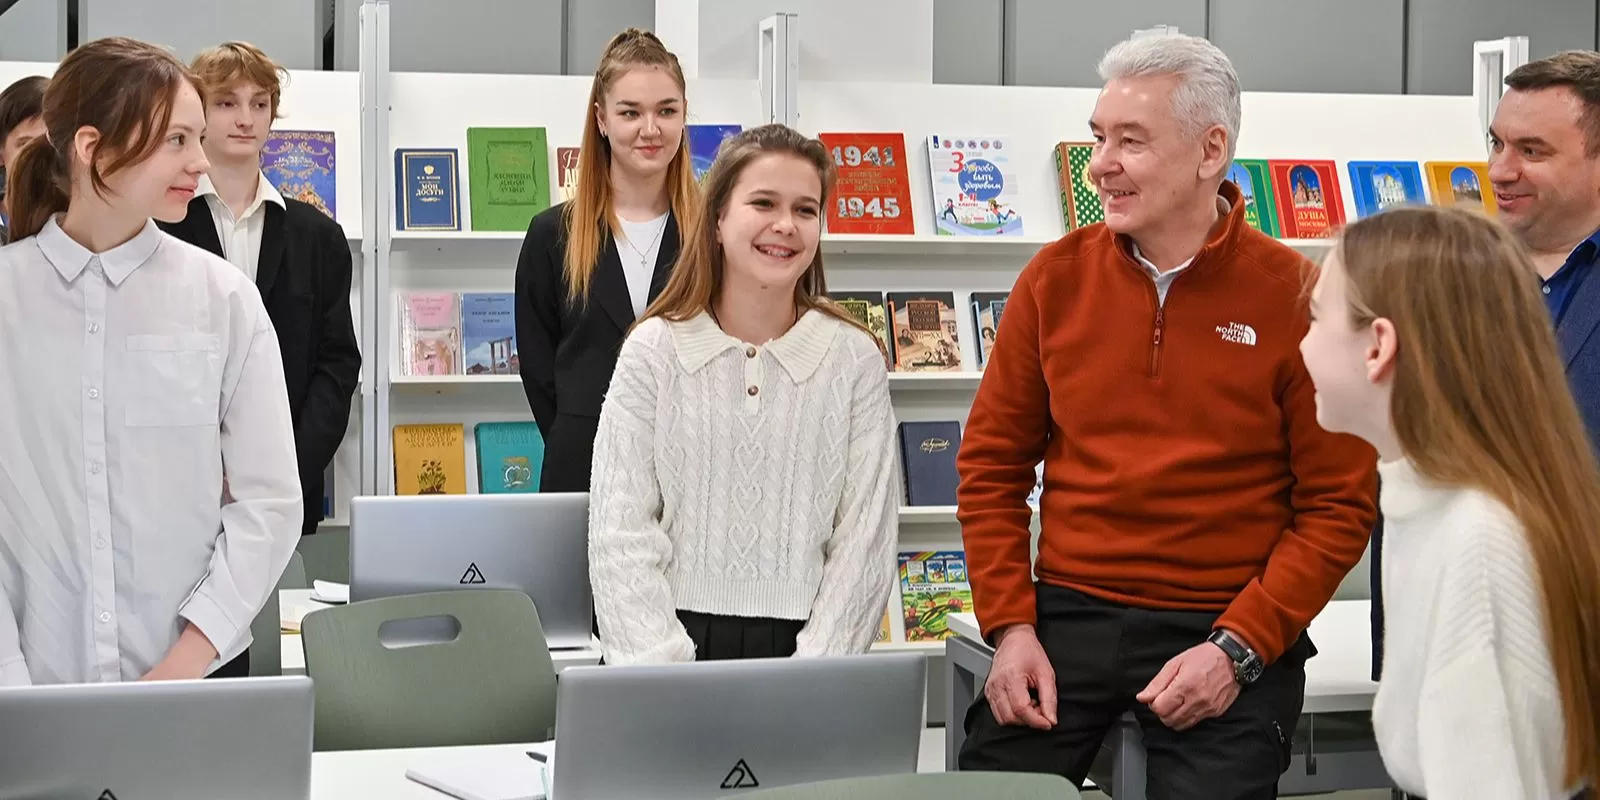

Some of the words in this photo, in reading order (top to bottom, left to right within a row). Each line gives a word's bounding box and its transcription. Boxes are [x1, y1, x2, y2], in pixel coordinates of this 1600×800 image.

[832, 145, 895, 167] 1941
[838, 197, 900, 218] 1945
[1298, 211, 1325, 220] ДУША
[1215, 325, 1244, 336] NORTH
[1229, 321, 1244, 330] THE
[1221, 333, 1242, 343] FACE
[924, 351, 932, 361] 2
